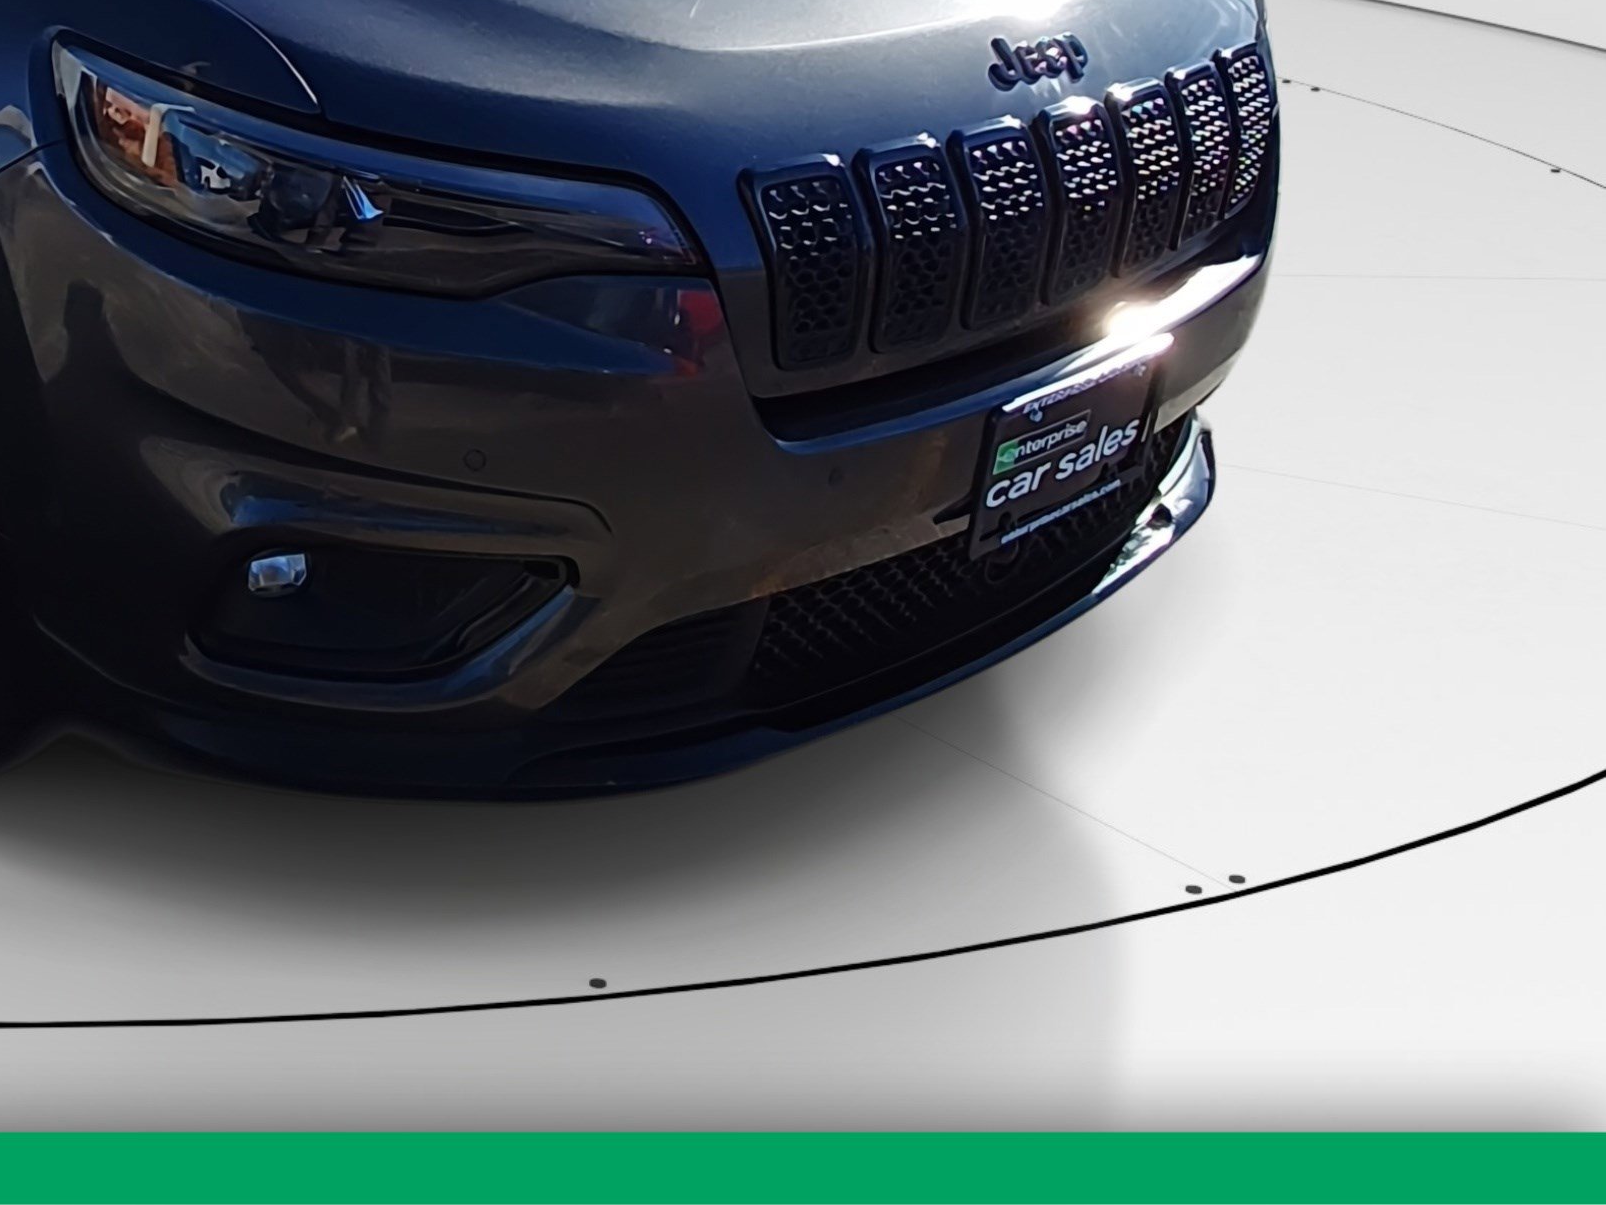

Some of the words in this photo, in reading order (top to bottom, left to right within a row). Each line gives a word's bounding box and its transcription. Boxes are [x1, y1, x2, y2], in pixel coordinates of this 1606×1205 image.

[988, 33, 1088, 91] Jeep
[986, 461, 1051, 508] car
[1055, 418, 1141, 481] sales
